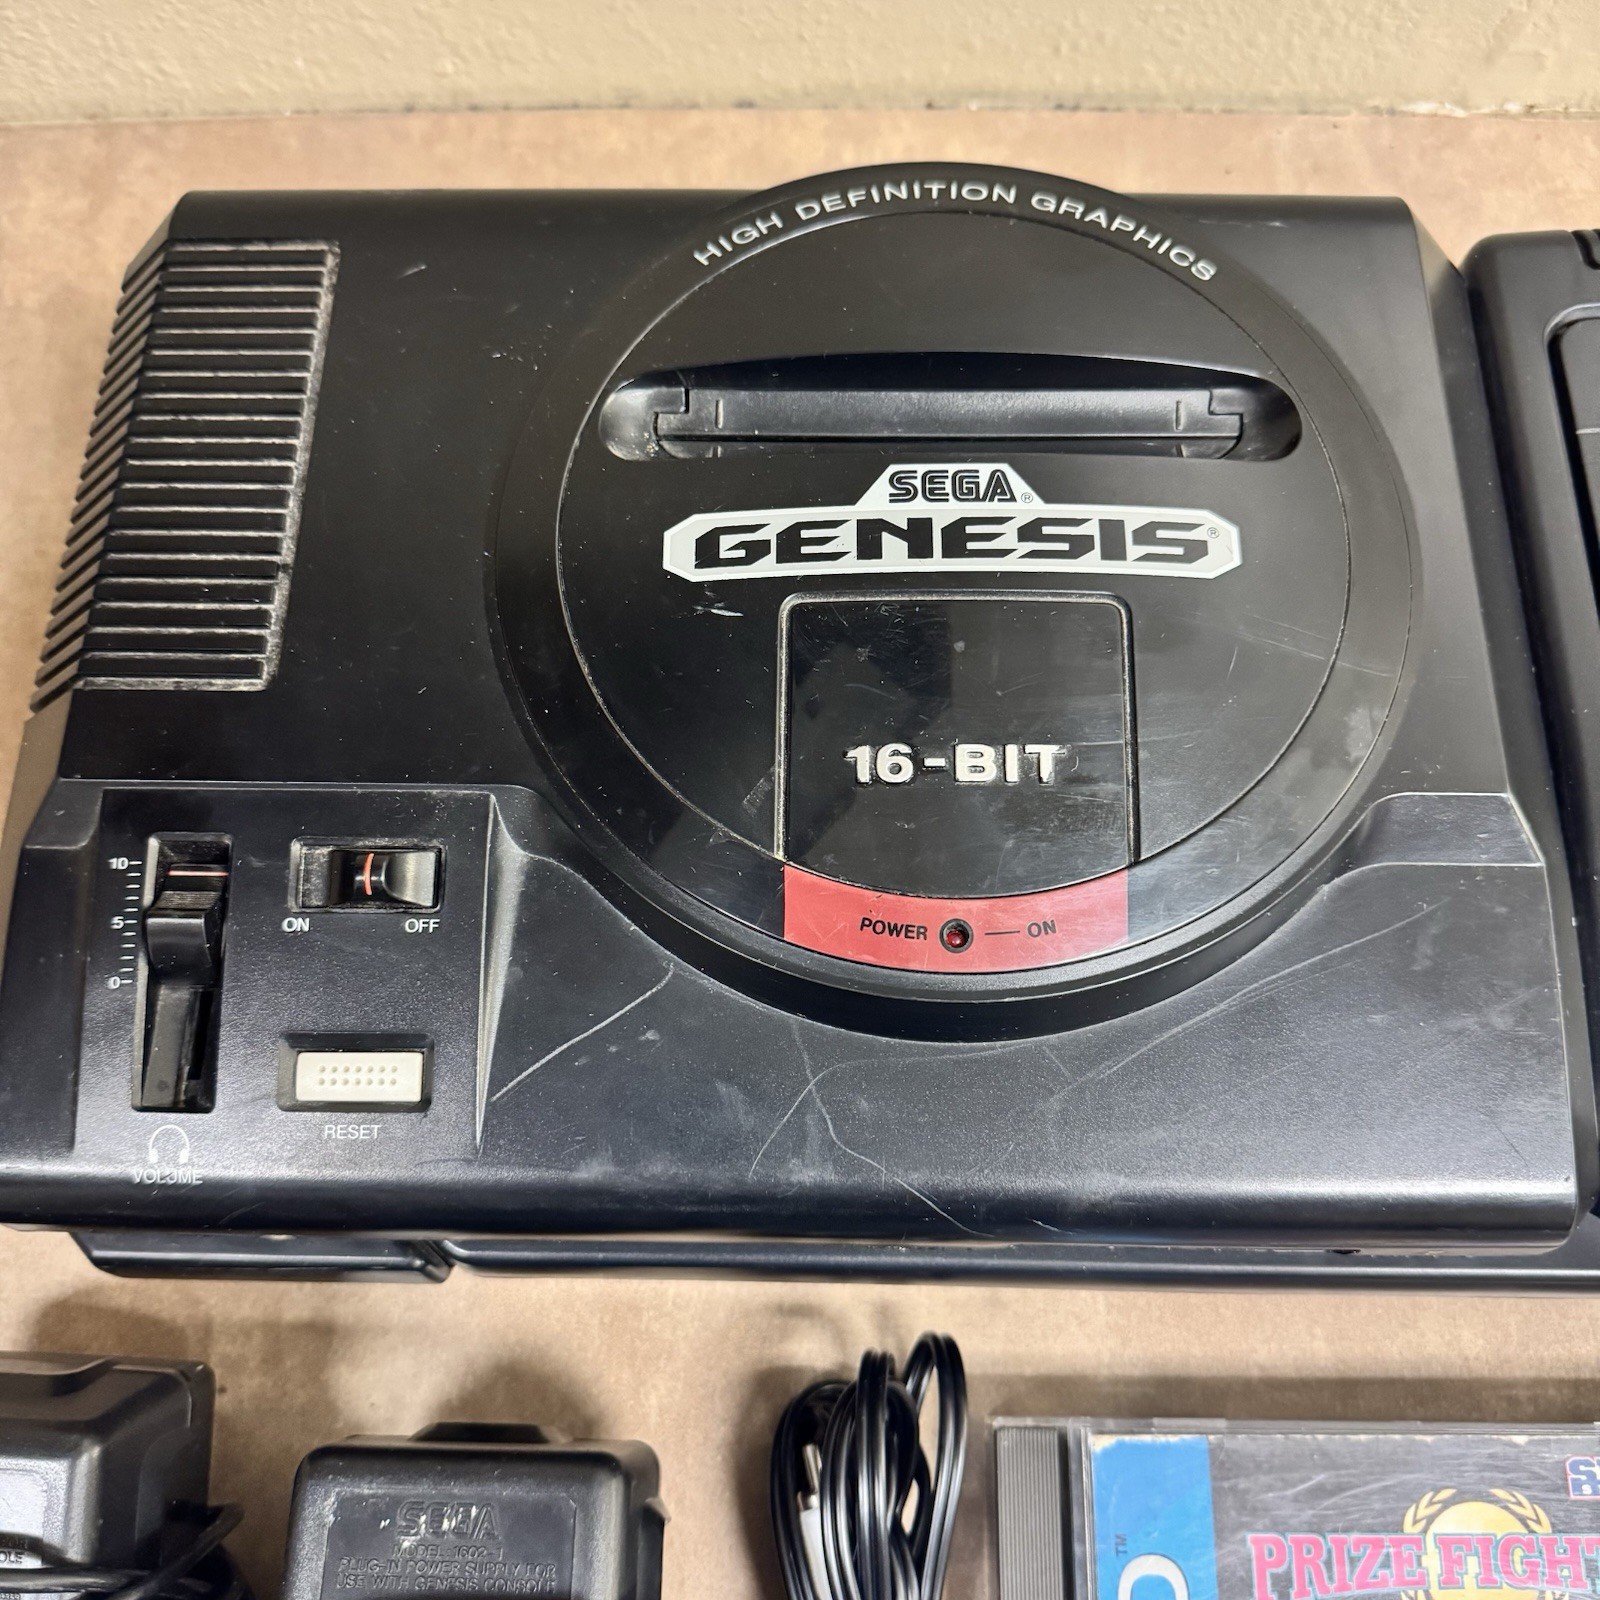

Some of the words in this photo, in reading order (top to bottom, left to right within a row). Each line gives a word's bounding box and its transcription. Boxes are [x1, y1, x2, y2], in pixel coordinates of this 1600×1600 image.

[693, 211, 784, 267] HIGH
[794, 180, 1018, 221] DEFINITION
[1030, 189, 1218, 281] GRAPHICS
[888, 469, 1018, 504] SEGA
[694, 516, 1209, 569] GENESIS
[845, 743, 1066, 786] 16-BIT
[108, 857, 129, 871] 10
[110, 916, 125, 930] 5
[281, 917, 310, 933] ON
[404, 918, 440, 934] OFF
[859, 917, 929, 942] POWER
[1026, 920, 1057, 938] ON
[108, 975, 121, 990] 0
[323, 1124, 381, 1141] RESET
[132, 1167, 204, 1185] VOLUME
[396, 1502, 500, 1540] SEGA
[1115, 1533, 1128, 1557] TM
[338, 1557, 400, 1574] PLUG-IN
[406, 1560, 460, 1576] POWER
[465, 1562, 521, 1577] SUPPLY
[525, 1563, 556, 1579] FOR
[1247, 1532, 1429, 1600] PRIZE
[336, 1574, 366, 1589] USE
[371, 1575, 410, 1591] WITH
[414, 1576, 478, 1592] GENESIS
